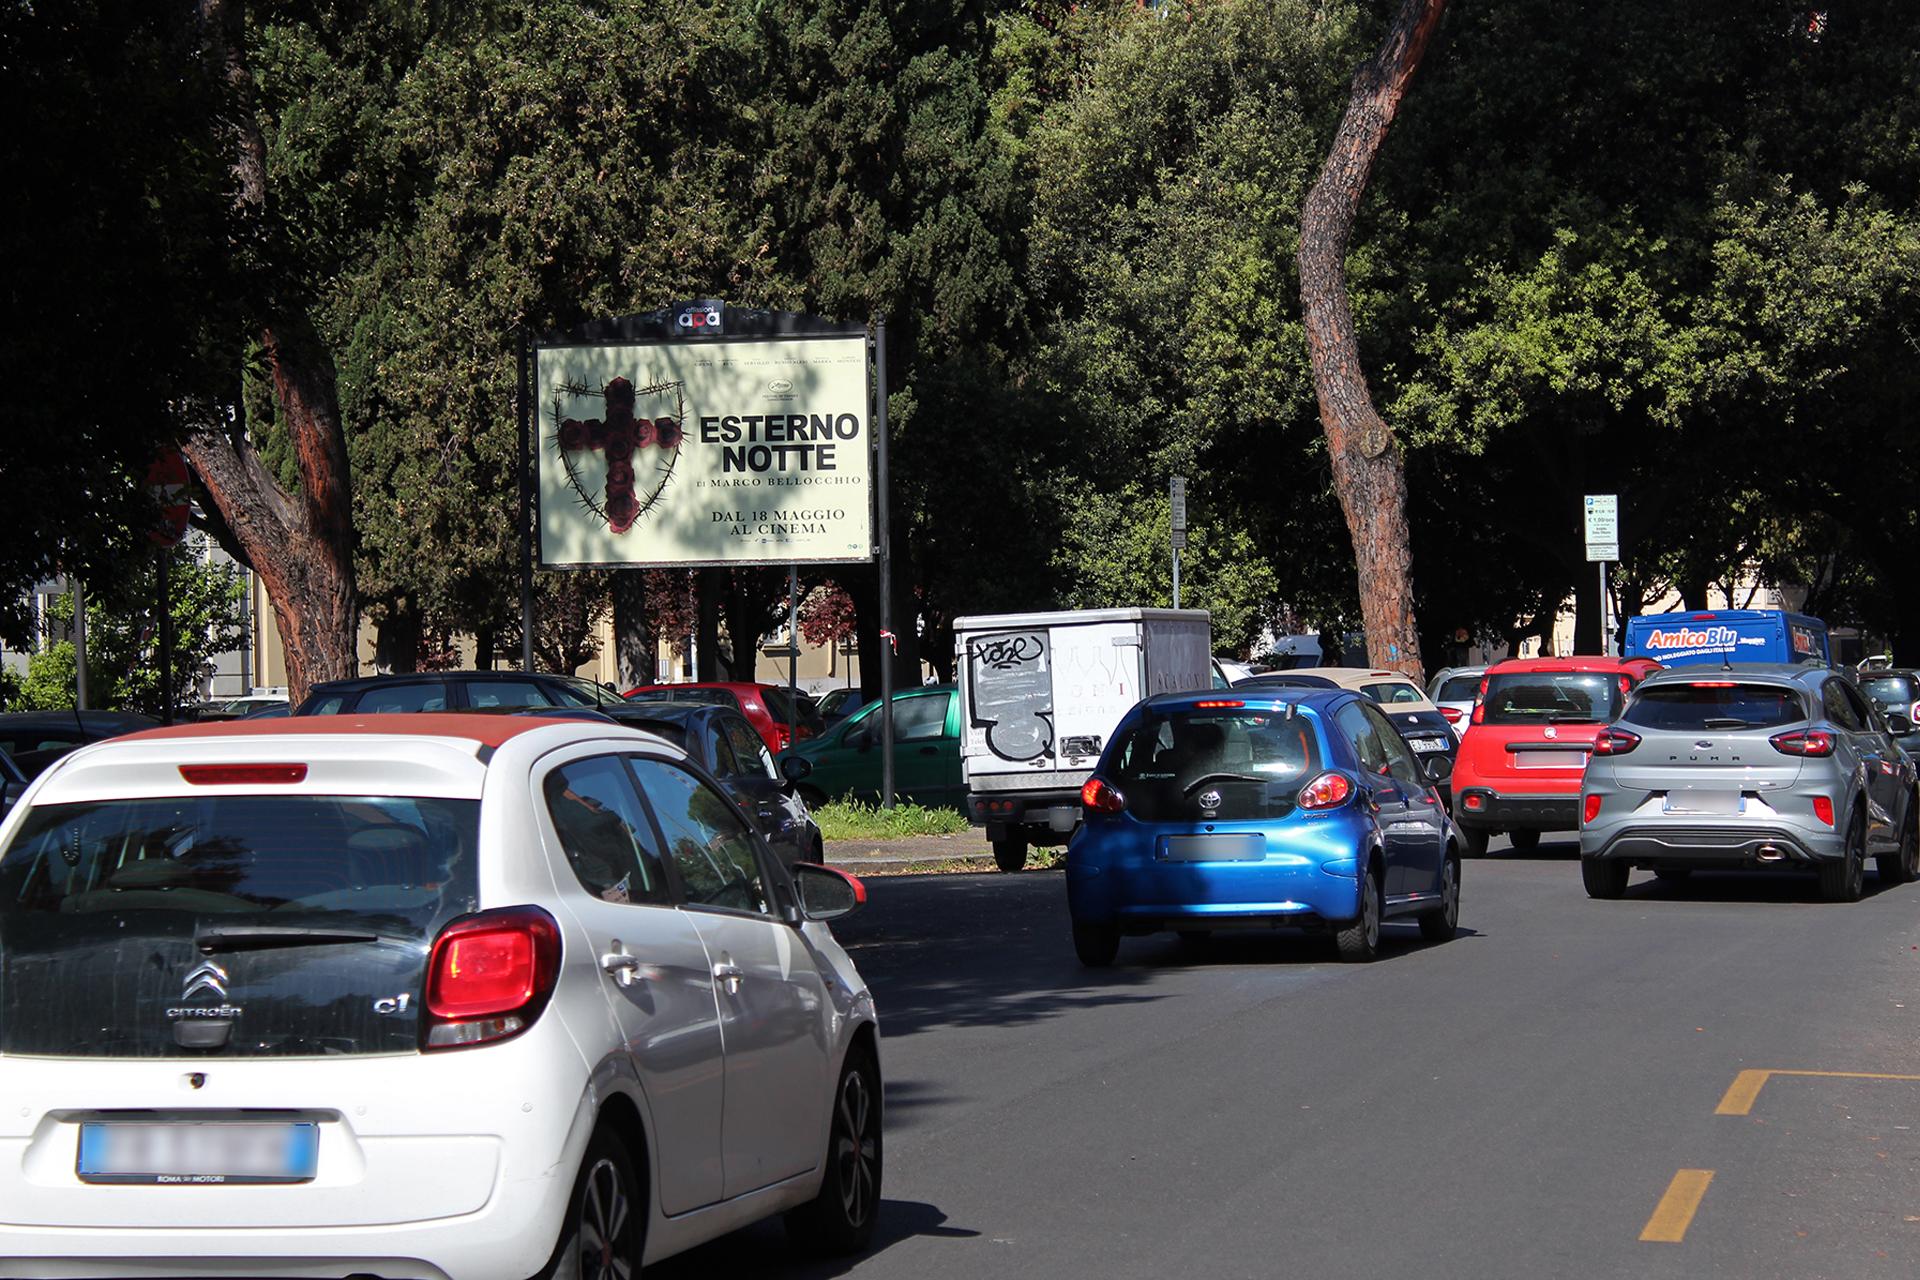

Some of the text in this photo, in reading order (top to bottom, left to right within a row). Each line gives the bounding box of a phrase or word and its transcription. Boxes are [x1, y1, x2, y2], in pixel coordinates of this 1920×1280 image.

[678, 312, 721, 329] apa
[700, 412, 860, 444] ESTERNO
[722, 443, 837, 473] NOTTE
[696, 476, 861, 488] DI MARCO BELLOCCHIO
[712, 508, 846, 523] DAL 18 MAGGIO
[730, 523, 827, 536] AL CINEMA
[1646, 626, 1737, 649] AmicoBlu
[166, 1004, 243, 1017] CITROËN
[373, 992, 411, 1014] C1
[157, 1175, 182, 1183] ROMA
